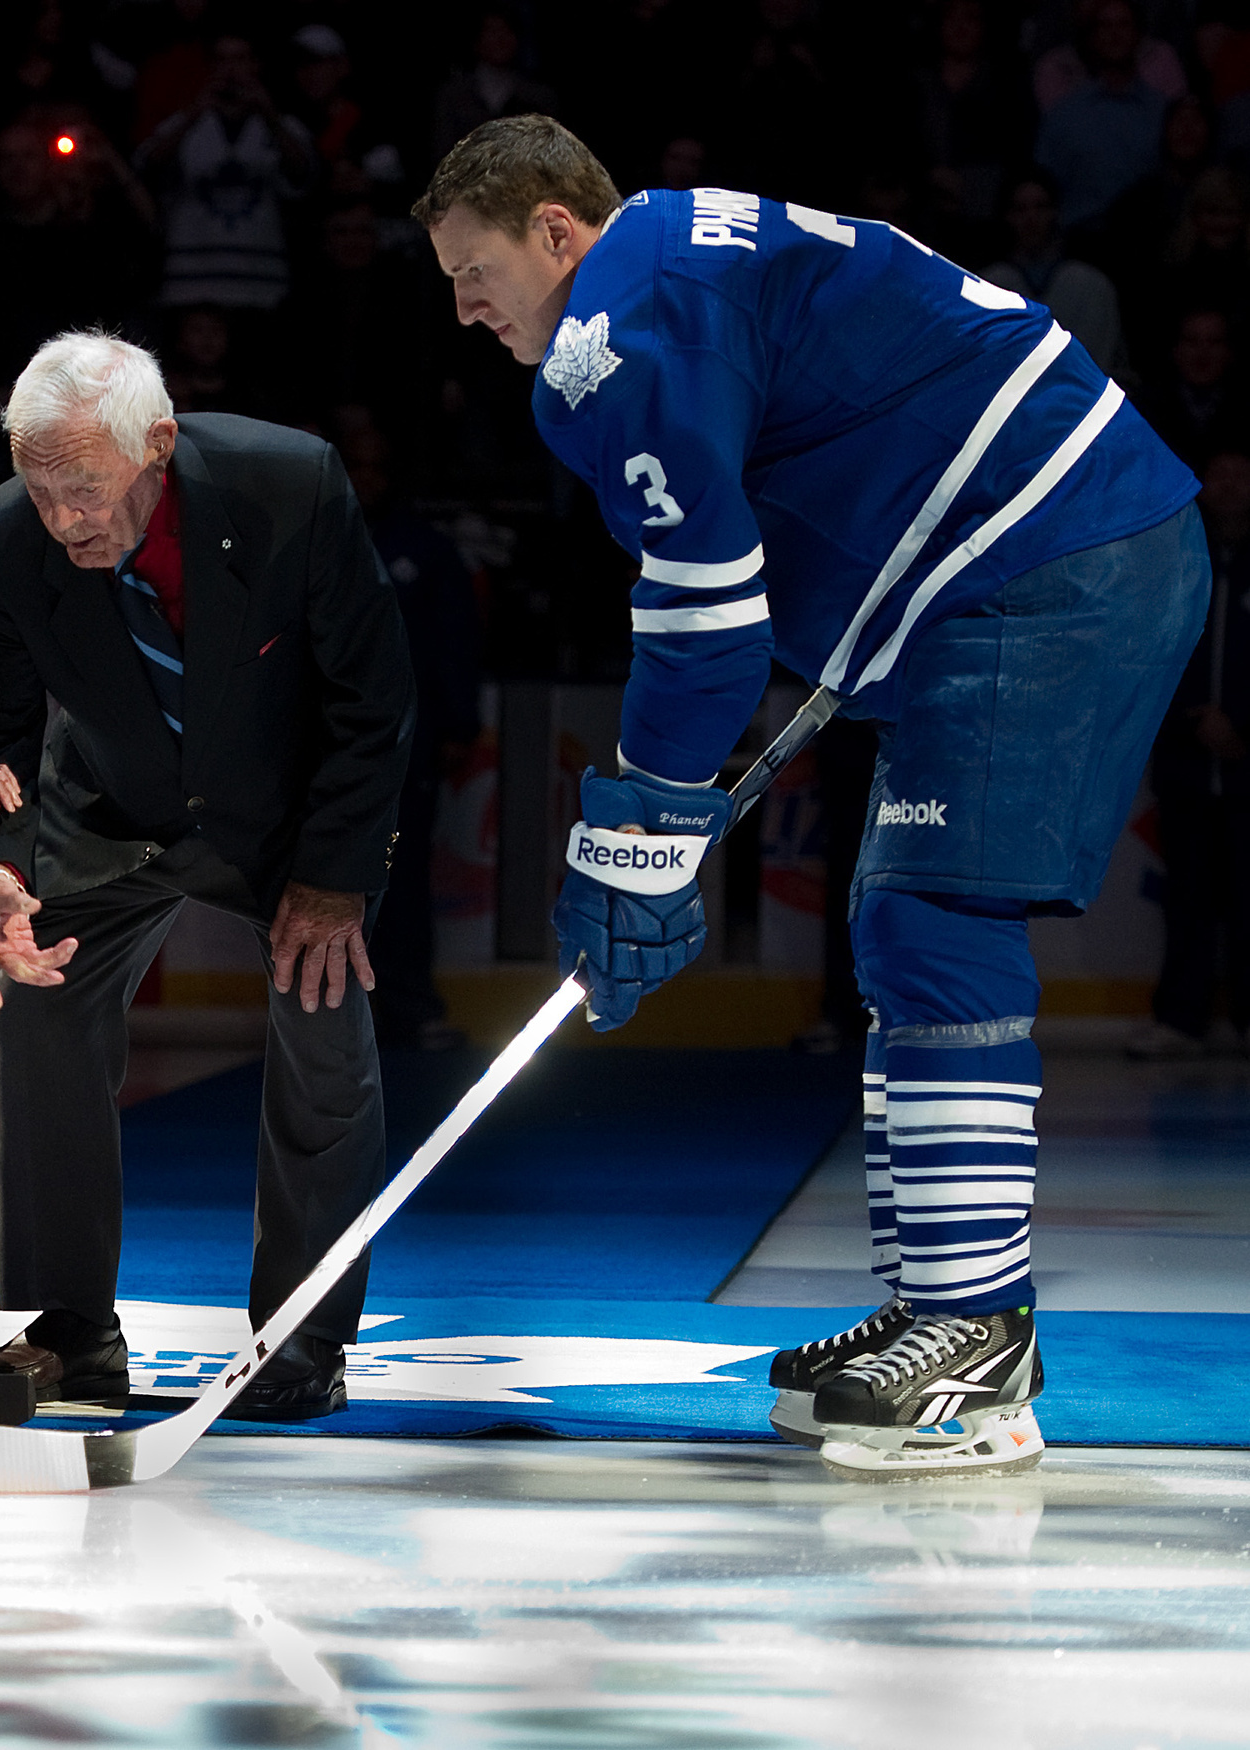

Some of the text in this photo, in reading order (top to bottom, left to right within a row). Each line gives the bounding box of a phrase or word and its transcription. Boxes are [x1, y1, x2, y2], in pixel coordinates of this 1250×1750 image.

[624, 452, 685, 527] 3
[659, 812, 715, 829] Phaneuf
[876, 798, 949, 827] Reebok
[577, 836, 686, 870] Reebok
